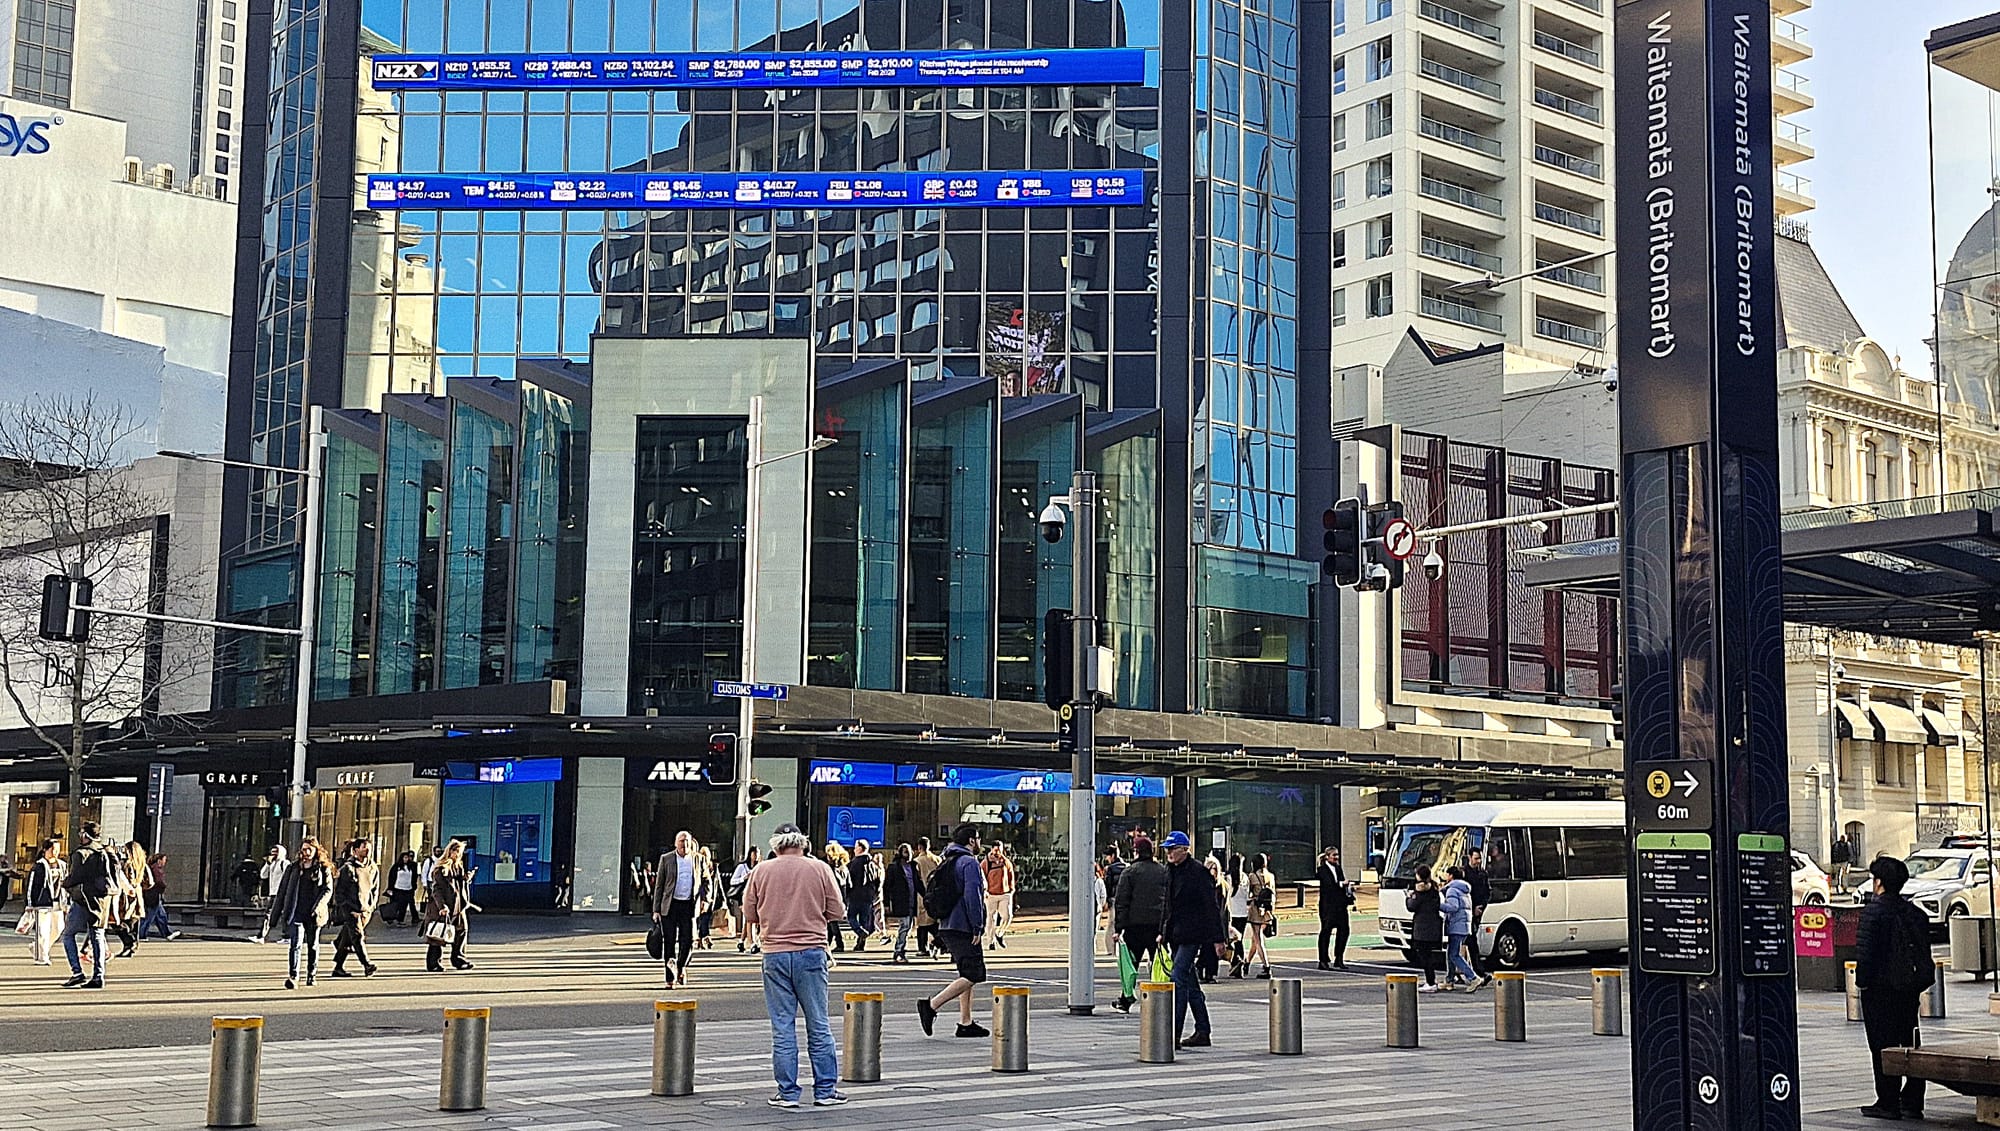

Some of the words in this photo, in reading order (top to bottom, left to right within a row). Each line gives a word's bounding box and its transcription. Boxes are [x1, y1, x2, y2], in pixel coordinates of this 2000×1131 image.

[377, 64, 418, 78] NZX
[445, 62, 468, 71] NZ10
[604, 61, 628, 70] NZ50
[689, 62, 710, 70] SMP
[765, 61, 786, 70] SMP
[842, 60, 863, 69] SMP
[1647, 10, 1673, 179] Waitematā
[1734, 14, 1753, 177] Waitematā
[1071, 178, 1093, 188] USD
[463, 186, 485, 195] TEM
[1646, 187, 1676, 358] (Britomart)
[1734, 185, 1756, 356] (Britomart)
[717, 683, 752, 695] CUSTOMS
[647, 761, 701, 781] ANZ
[810, 766, 842, 782] ANZ
[206, 772, 259, 785] GRAFF
[337, 771, 375, 785] GRAFF
[1016, 776, 1044, 791] ANZ
[1108, 780, 1134, 795] ANZ
[1657, 804, 1689, 819] 60m
[1800, 930, 1813, 938] Rail
[1806, 939, 1821, 948] stop
